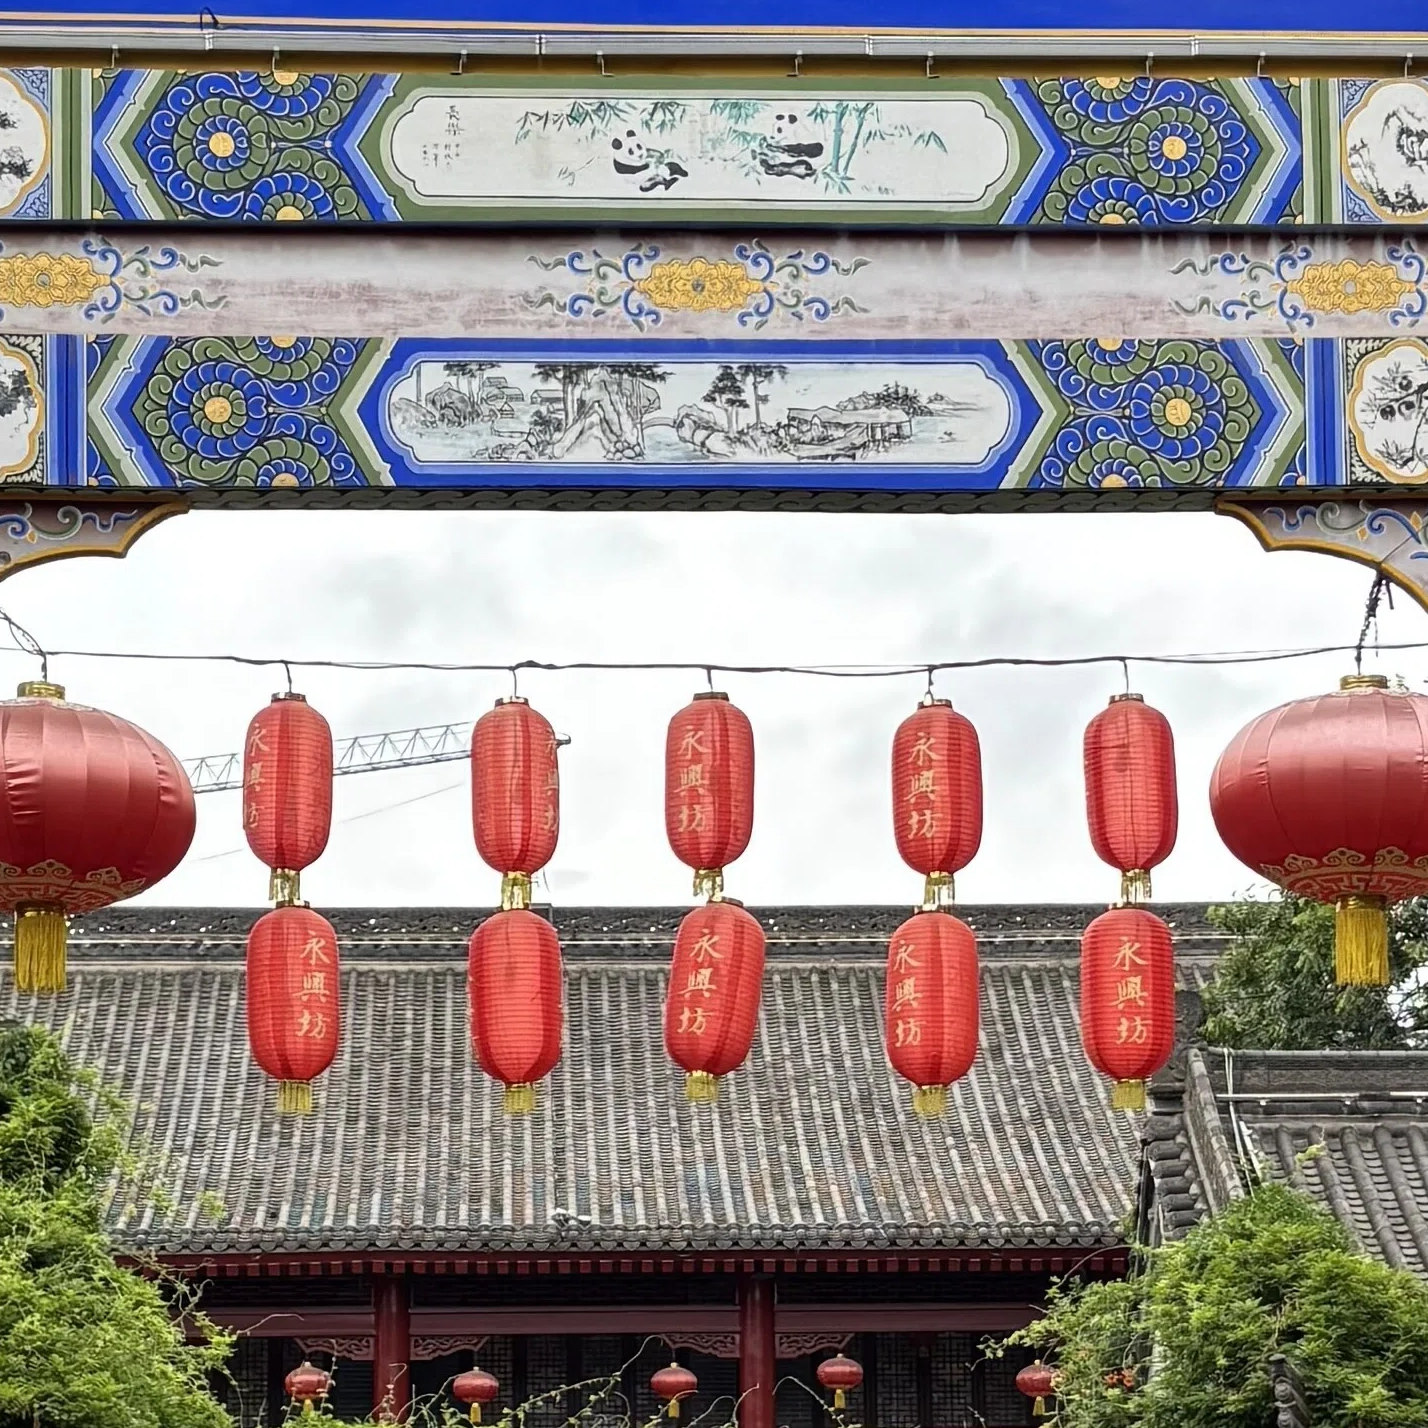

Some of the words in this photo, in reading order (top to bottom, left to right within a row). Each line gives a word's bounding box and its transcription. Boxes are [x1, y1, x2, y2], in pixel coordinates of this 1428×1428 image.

[674, 725, 711, 834] 永興坊
[907, 732, 946, 840] 永興坊
[292, 930, 331, 1039] 永興坊
[677, 928, 723, 1036] 永興坊
[893, 939, 927, 1048] 永興坊
[1110, 936, 1151, 1046] 永興坊
